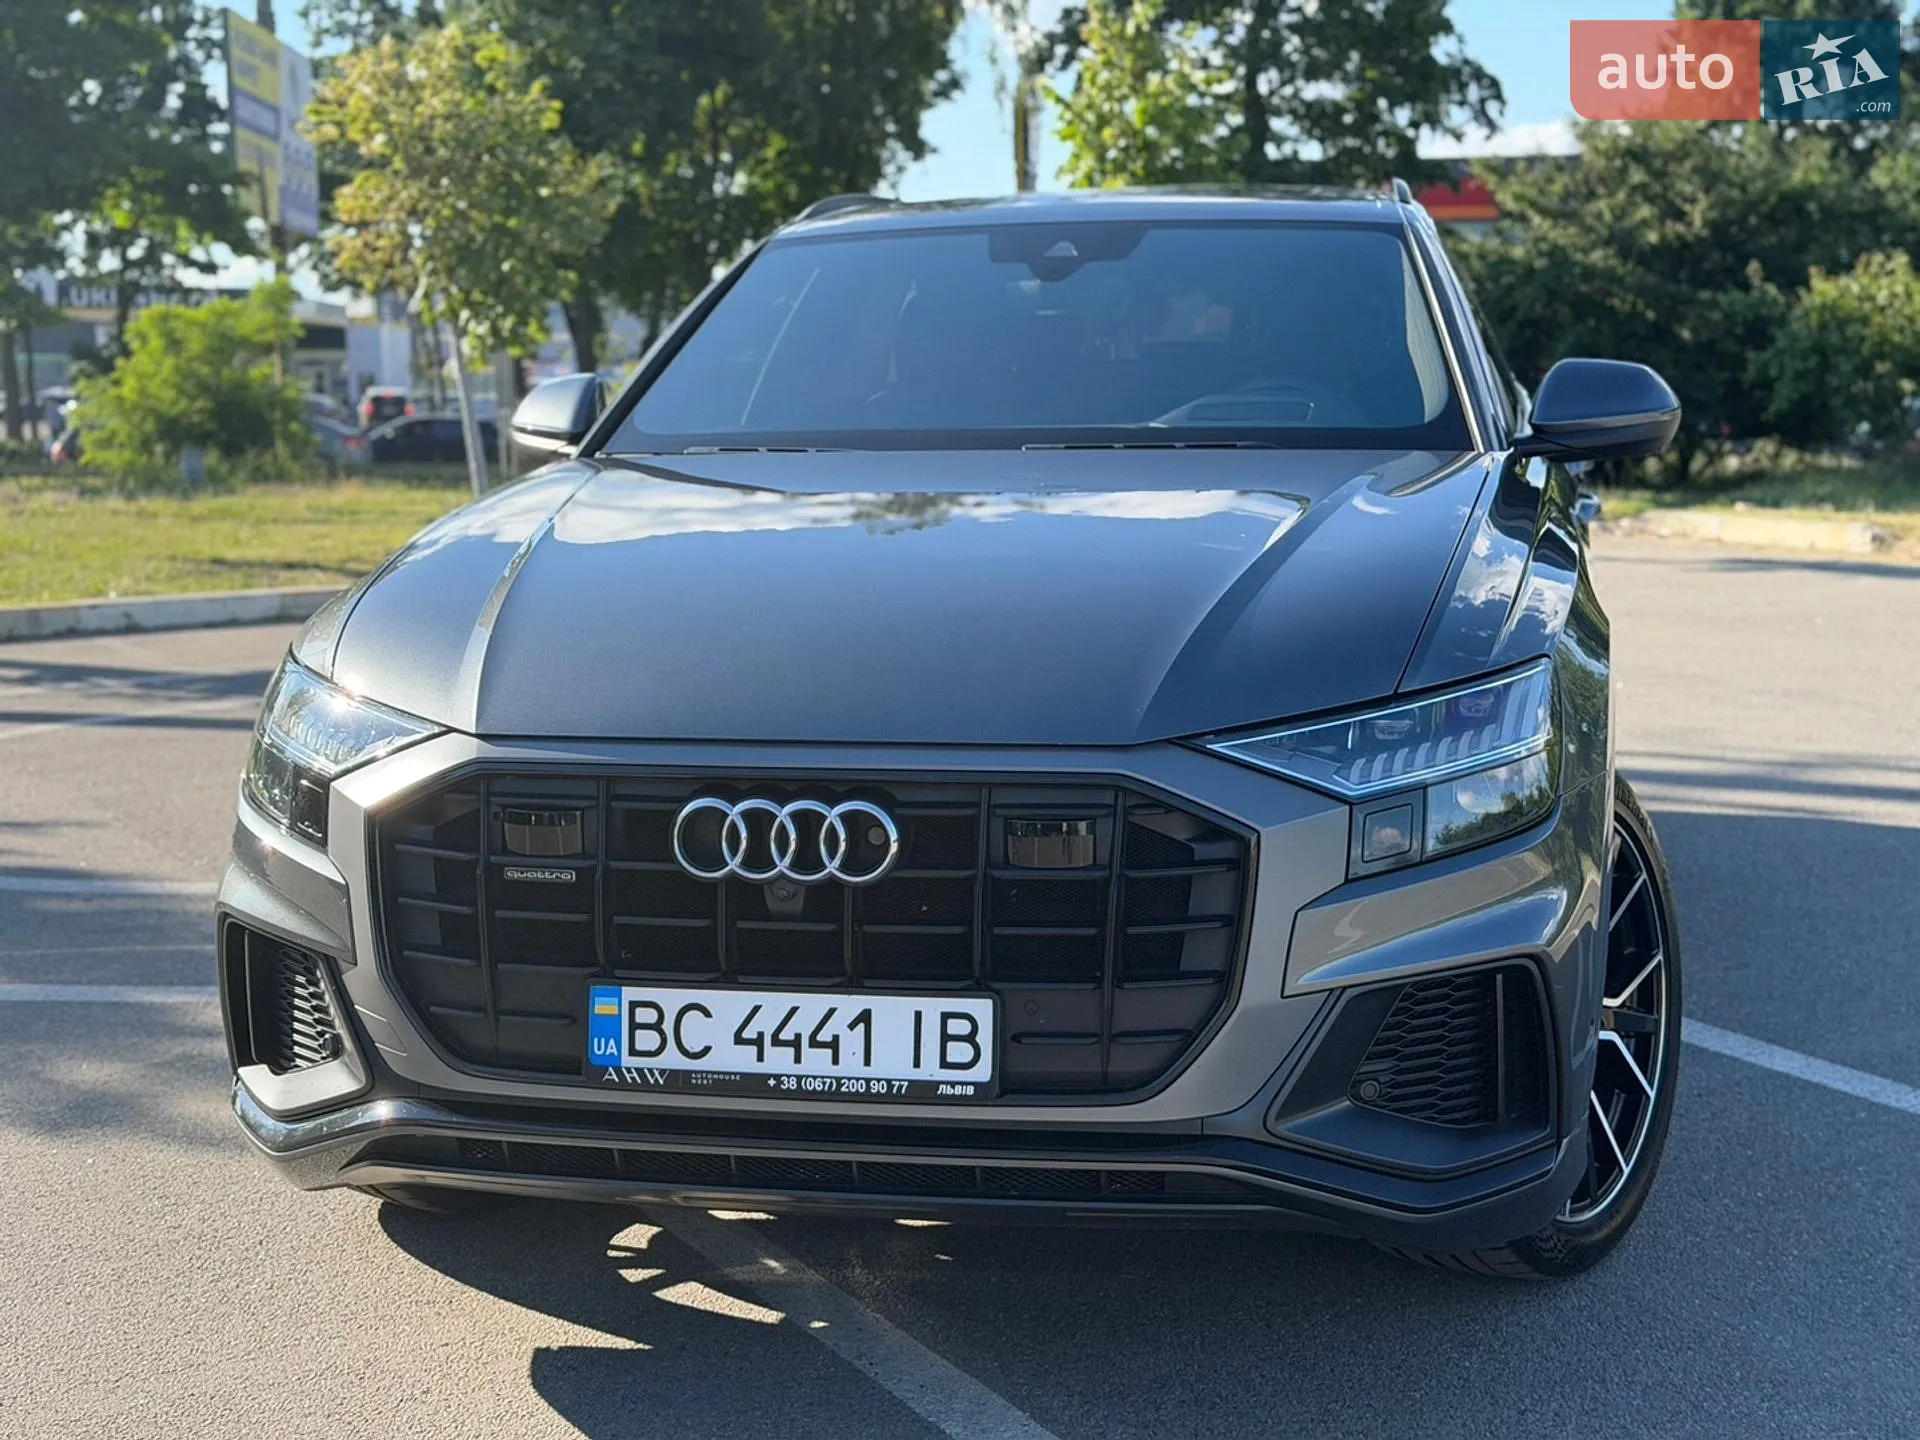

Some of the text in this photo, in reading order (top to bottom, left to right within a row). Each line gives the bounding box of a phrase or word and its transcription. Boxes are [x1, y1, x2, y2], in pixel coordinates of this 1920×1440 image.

[507, 870, 572, 880] quattro
[628, 1000, 982, 1070] BC 4441 IB
[593, 1037, 618, 1056] UA
[602, 1066, 670, 1085] AHW
[780, 1076, 797, 1090] 38
[801, 1076, 837, 1092] (067)
[840, 1078, 866, 1093] 200
[870, 1080, 887, 1094] 90
[891, 1081, 909, 1094] 77
